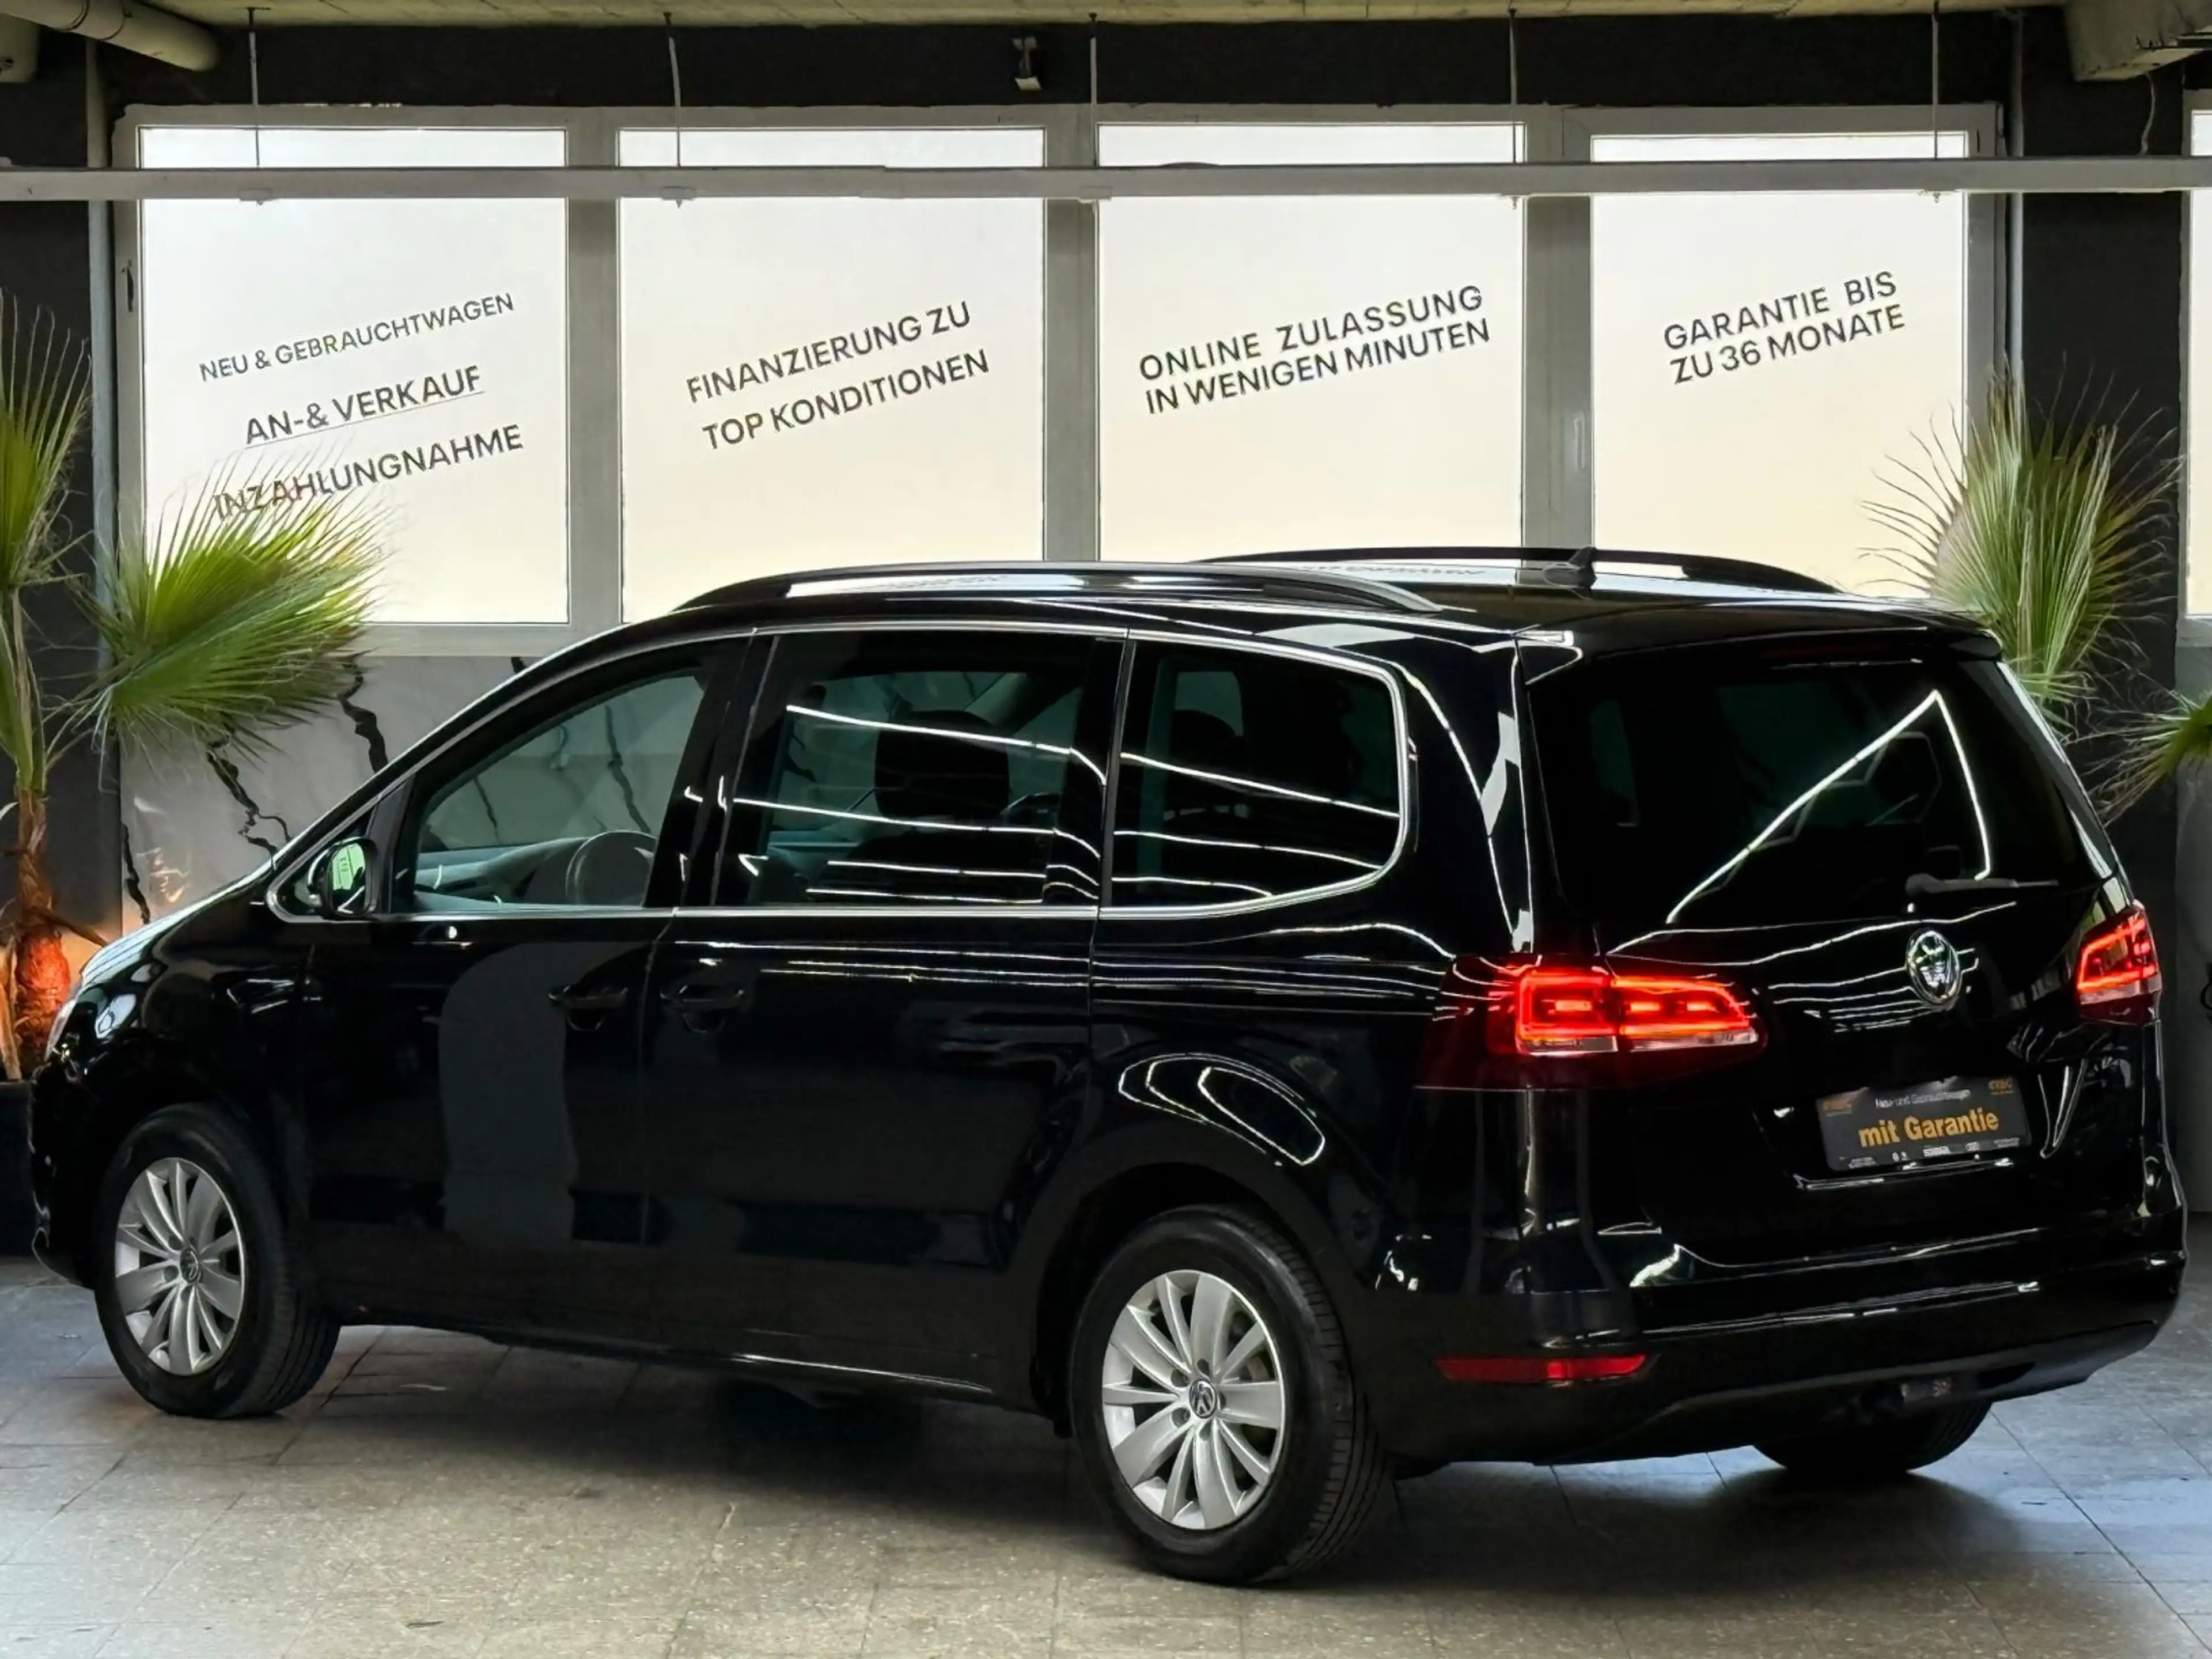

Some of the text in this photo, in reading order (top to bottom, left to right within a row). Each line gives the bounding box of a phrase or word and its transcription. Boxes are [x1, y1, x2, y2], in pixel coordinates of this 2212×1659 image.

[200, 293, 514, 381] NEU & GEBRAUCHTWAGEN
[687, 301, 970, 403] FINANZIERUNG ZU
[1139, 285, 1482, 380] ONLINE ZULASSUNG
[1664, 271, 1896, 350] GARANTIE BIS
[1670, 304, 1905, 385] ZU 36 MONATE
[332, 365, 480, 422] VERKAUF
[702, 349, 989, 449] TOP KONDITIONEN
[1146, 318, 1490, 414] IN WENIGEN MINUTEN
[214, 424, 523, 520] INZAHLUNGNAHME
[1858, 1106, 1999, 1148] mit Garantie
